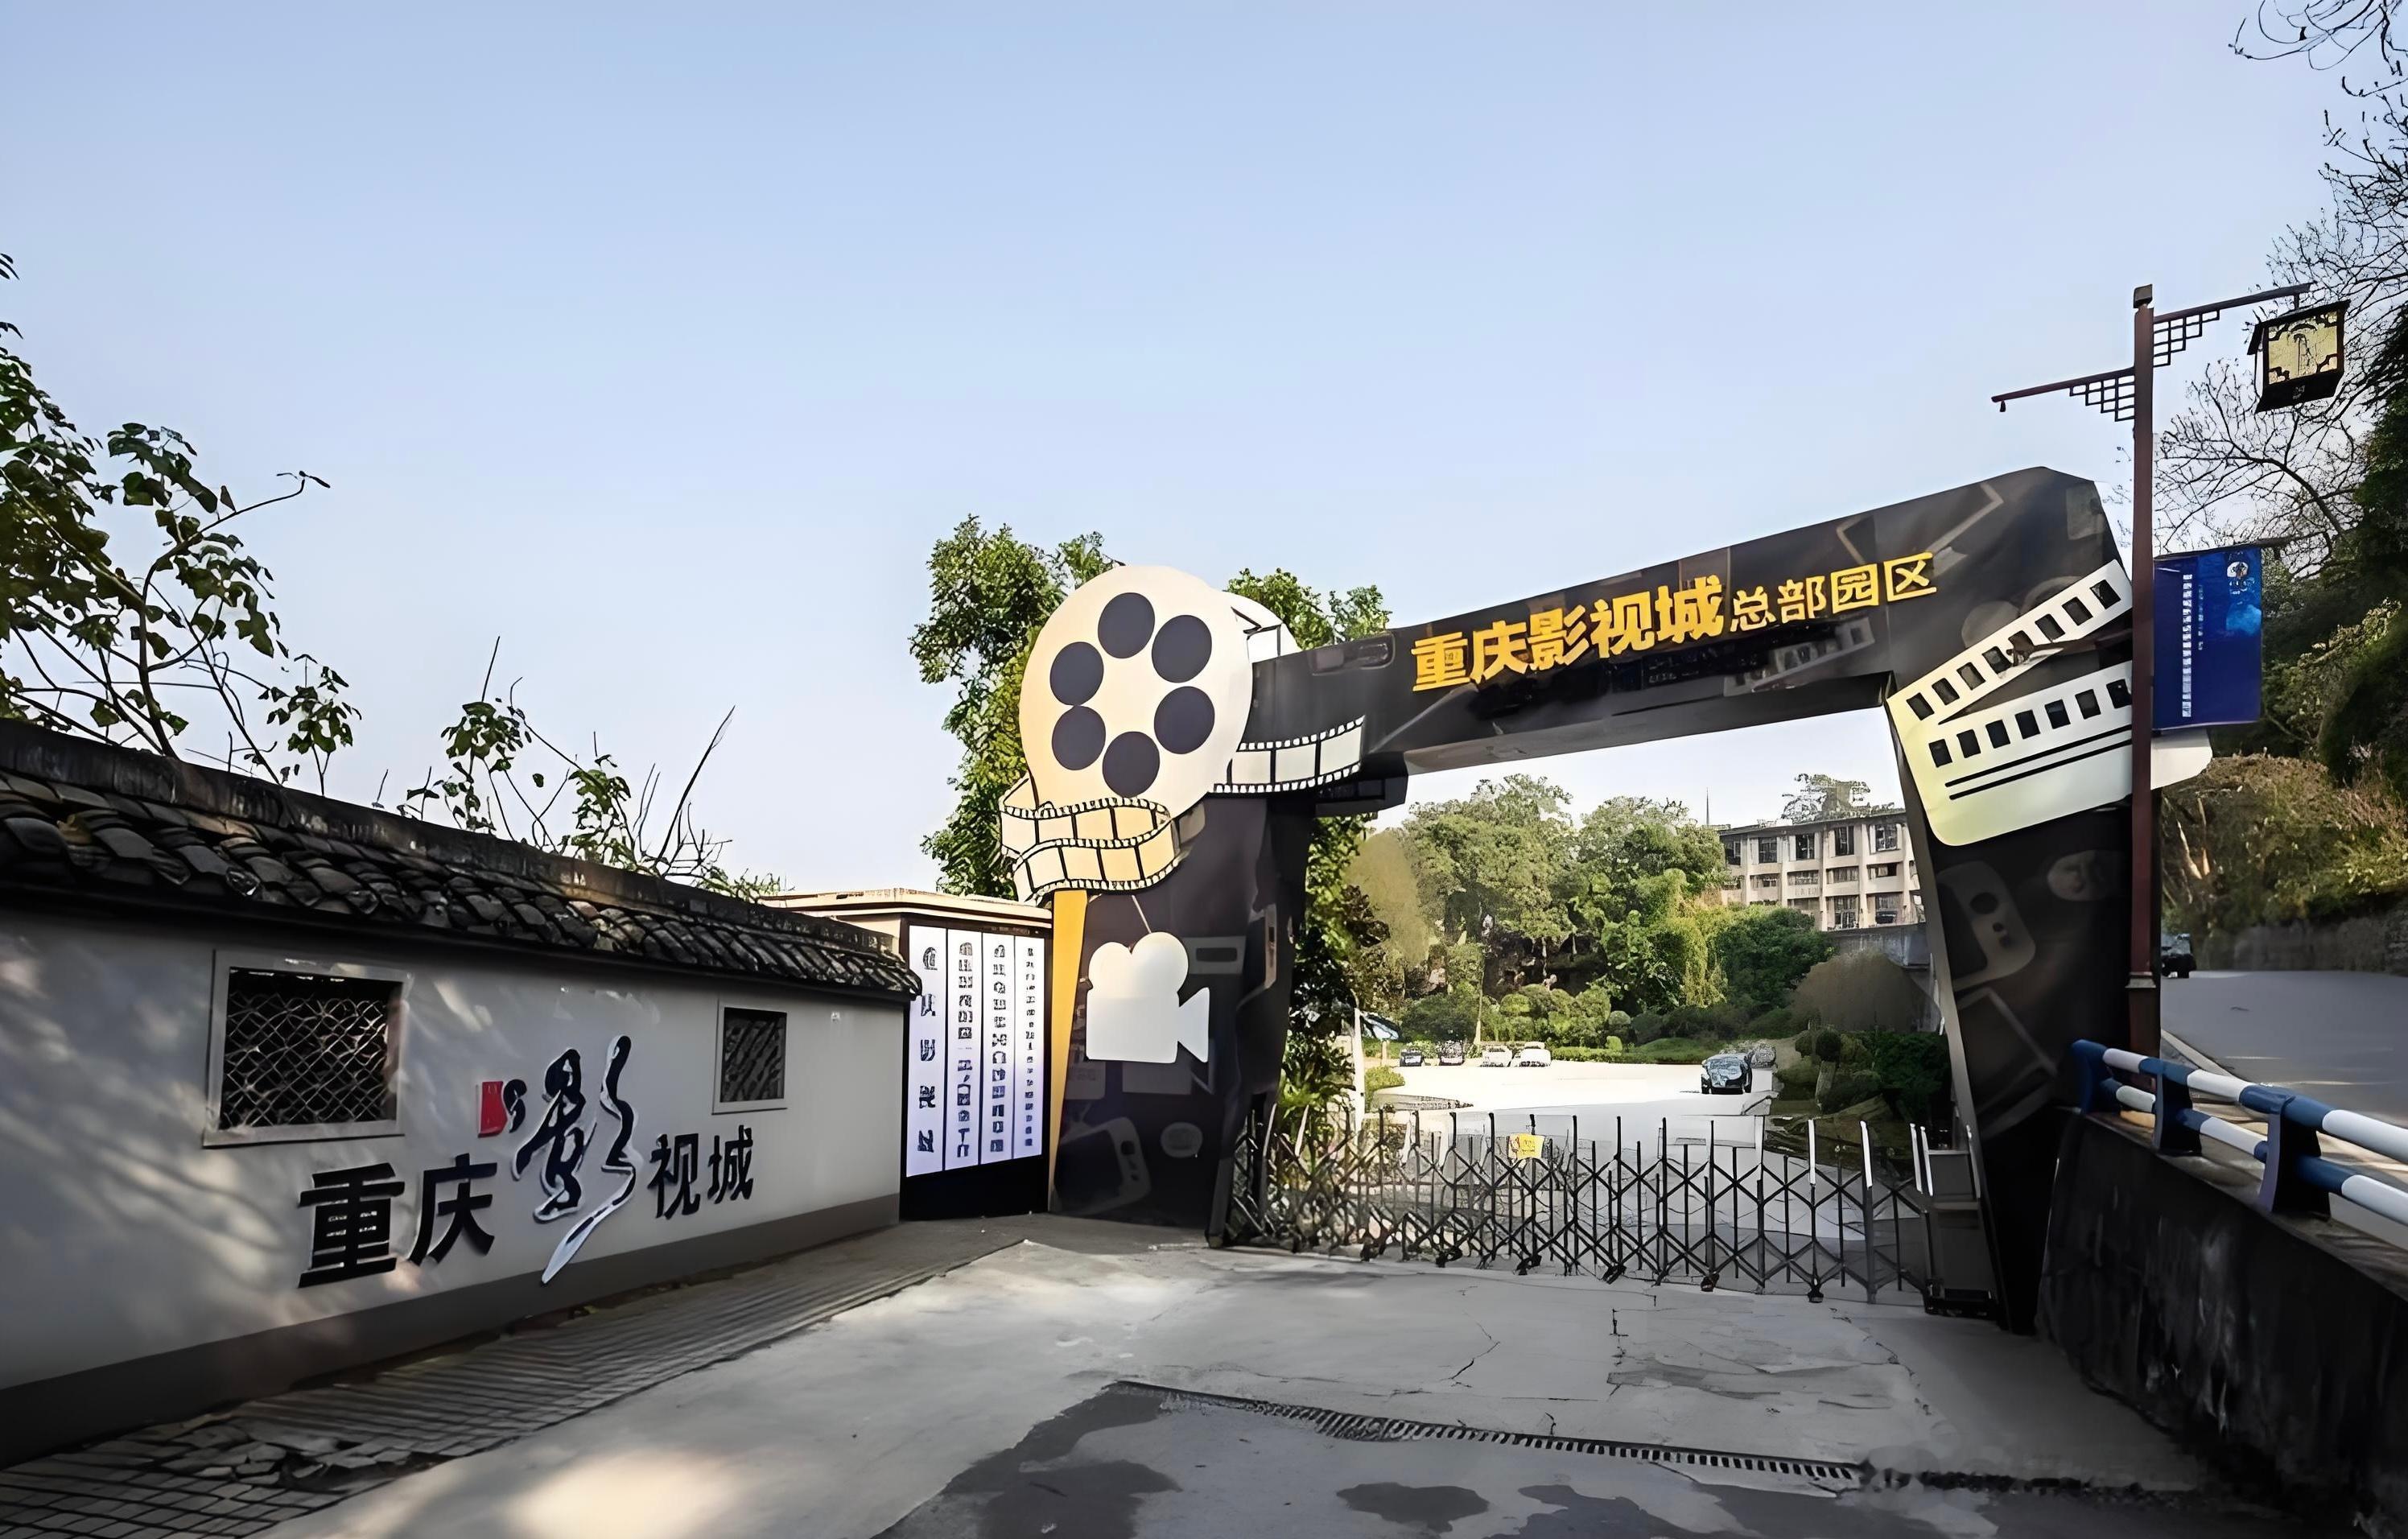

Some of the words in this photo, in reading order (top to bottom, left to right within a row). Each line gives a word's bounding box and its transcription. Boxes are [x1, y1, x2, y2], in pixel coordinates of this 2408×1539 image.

[298, 1035, 755, 1287] 重庆影视城
